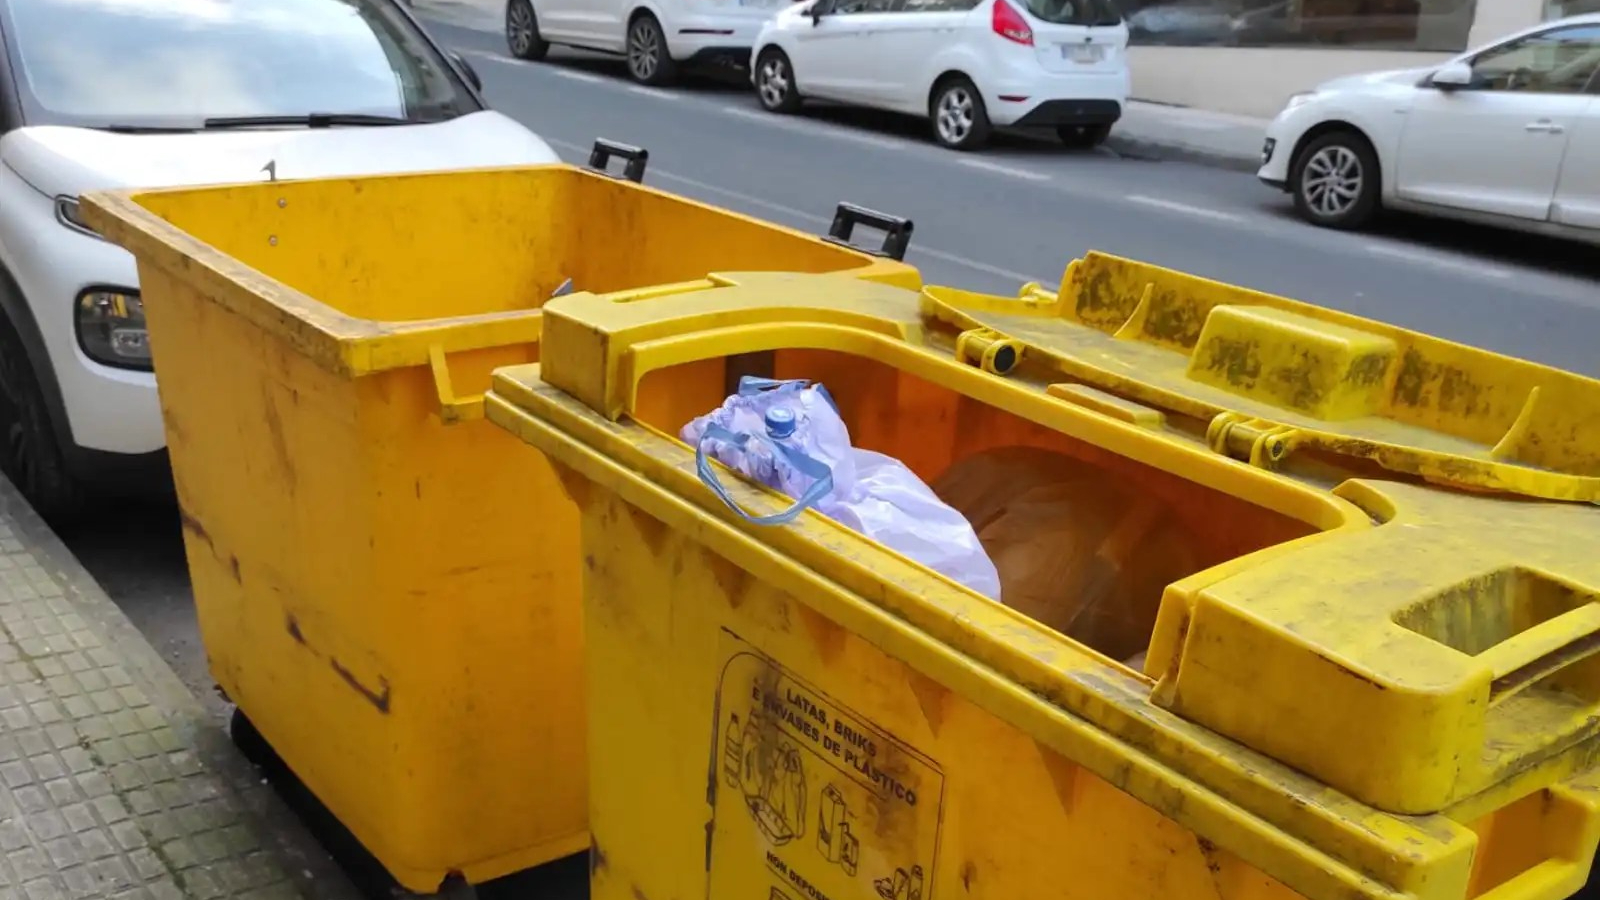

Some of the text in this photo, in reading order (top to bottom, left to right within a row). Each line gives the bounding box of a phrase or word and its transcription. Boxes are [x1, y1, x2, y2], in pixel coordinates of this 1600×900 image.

[752, 686, 760, 701] E
[823, 735, 841, 758] DE
[786, 688, 877, 757] LATAS, BRIKS
[766, 851, 787, 874] NON
